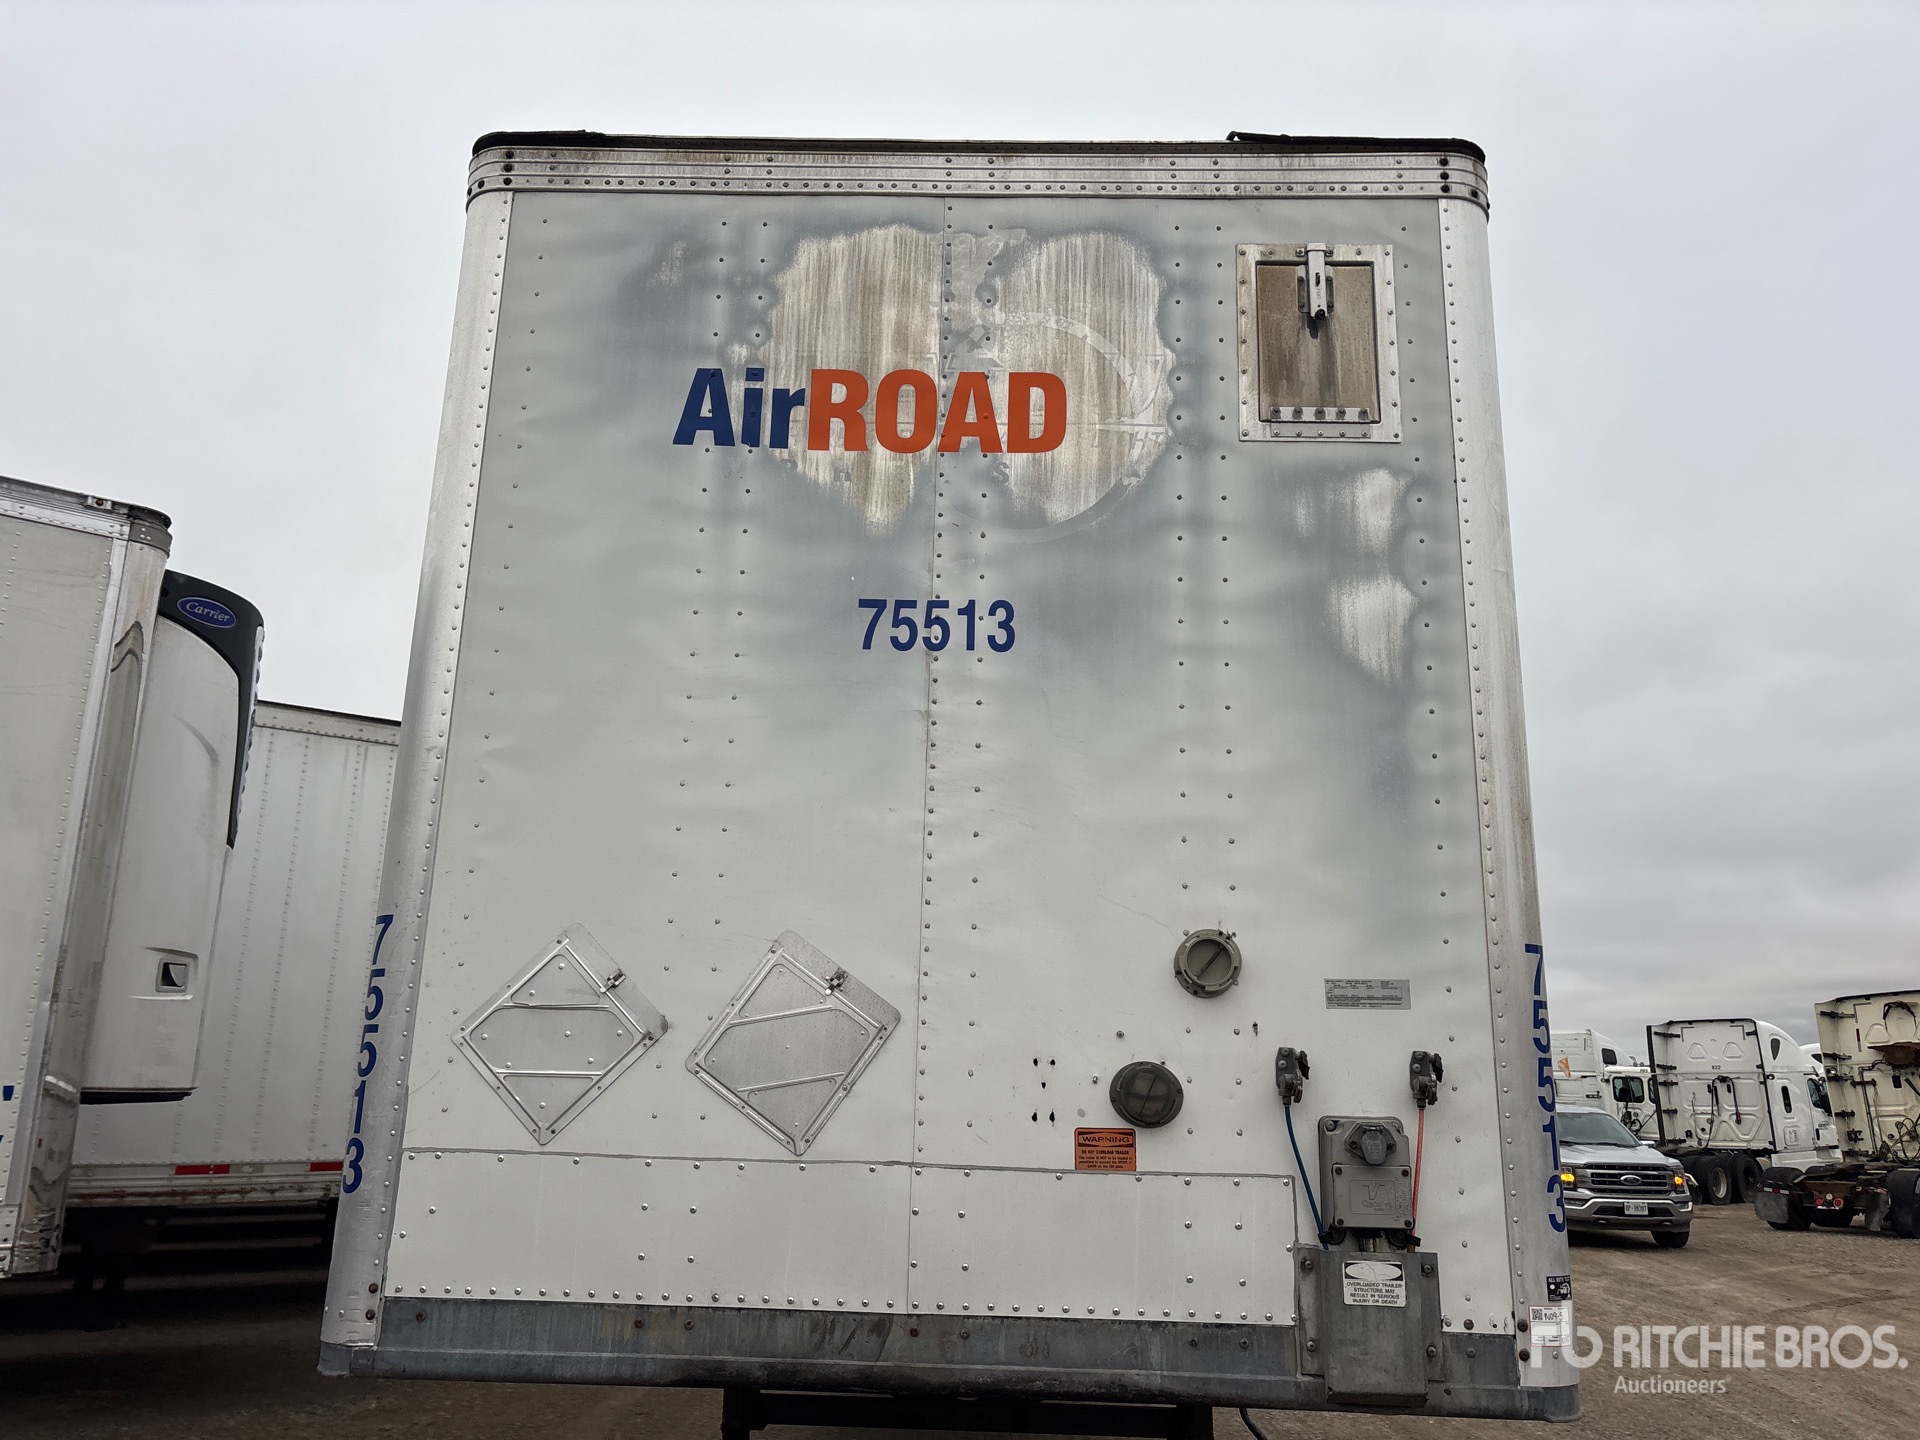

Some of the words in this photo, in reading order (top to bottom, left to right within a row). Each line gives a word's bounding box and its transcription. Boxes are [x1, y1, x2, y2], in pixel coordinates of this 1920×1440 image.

[672, 367, 1067, 454] AirROAD
[186, 602, 231, 622] Carrier
[857, 598, 1016, 653] 75513
[342, 914, 394, 1194] 75513
[1524, 943, 1567, 1233] 75513
